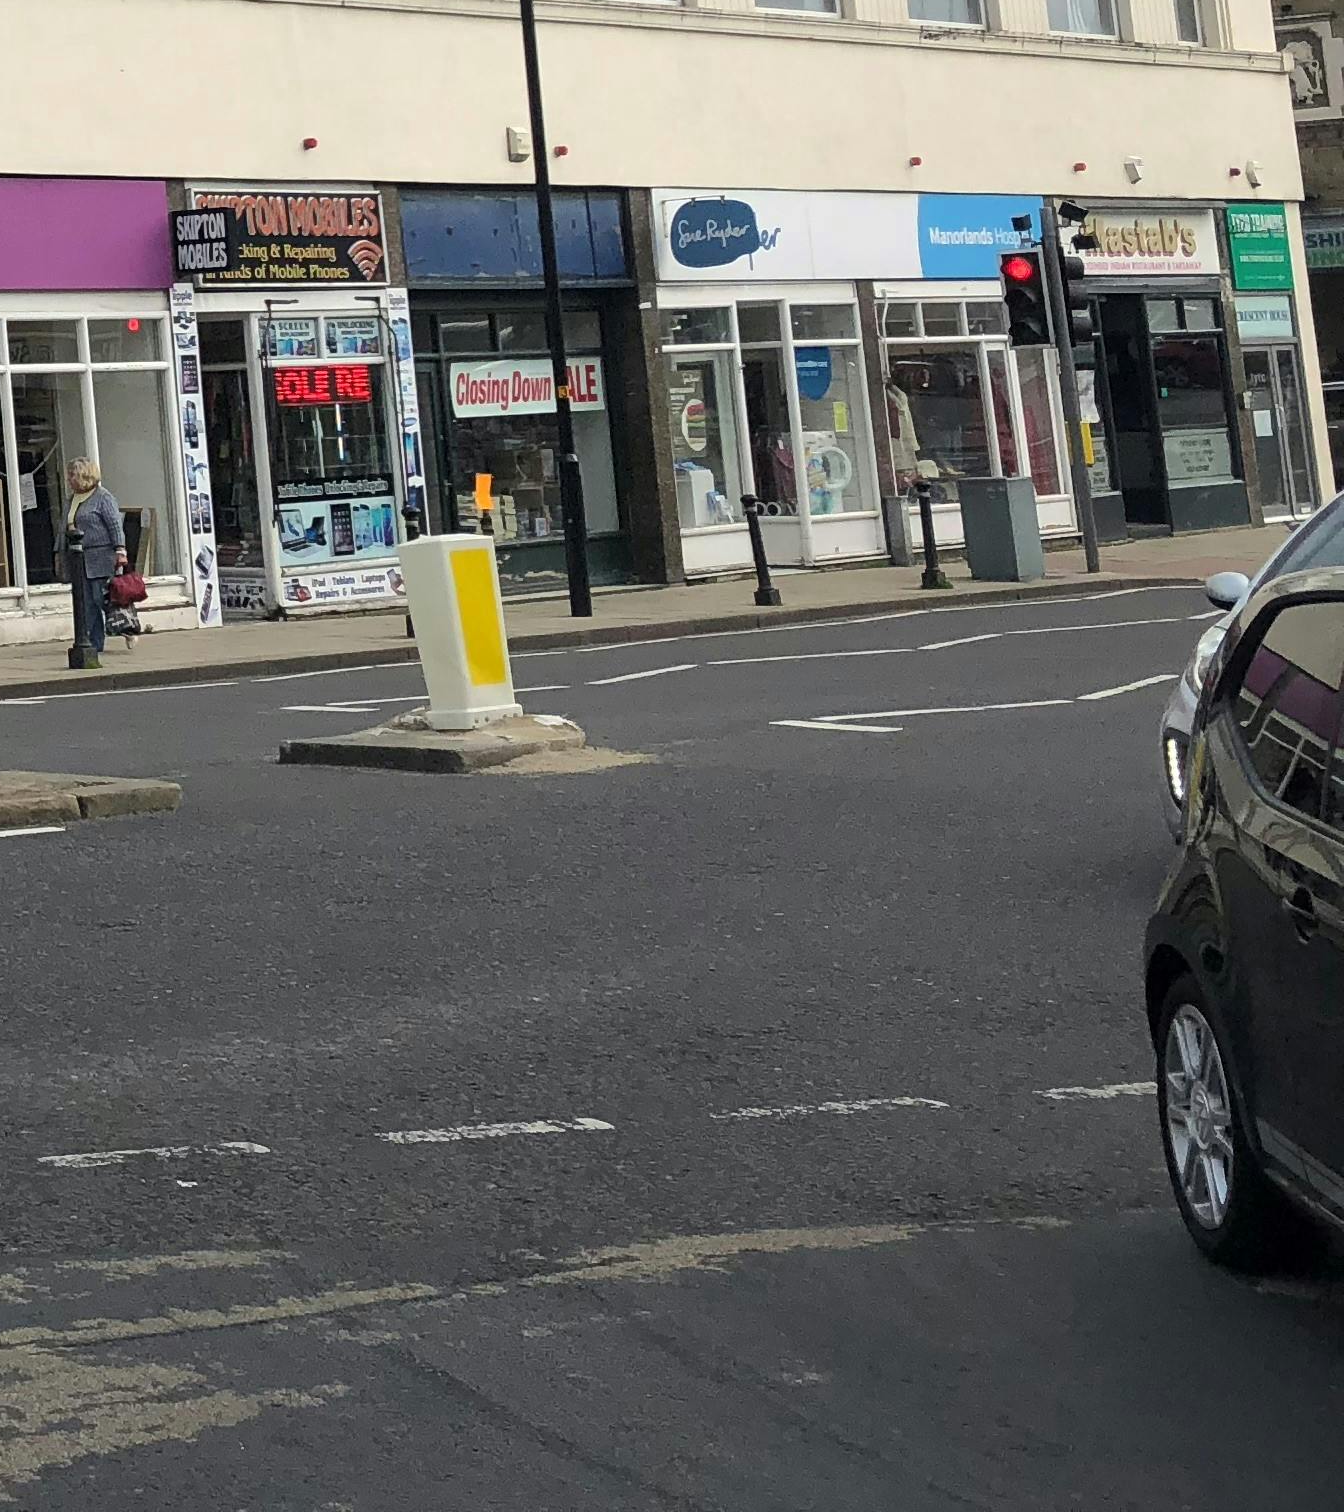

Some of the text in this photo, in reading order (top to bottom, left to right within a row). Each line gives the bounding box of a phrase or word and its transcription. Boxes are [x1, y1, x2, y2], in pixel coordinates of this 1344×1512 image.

[176, 212, 226, 241] SKIPTON
[195, 194, 378, 237] PTON MOBILES
[678, 219, 706, 248] Sue
[706, 219, 750, 248] Ryder
[929, 227, 994, 245] Manorlands
[1305, 233, 1343, 248] SHI
[177, 241, 228, 271] MOBILES
[239, 243, 337, 262] cking & Repairing
[255, 264, 267, 279] of
[269, 264, 308, 279] Mobile
[309, 264, 350, 279] Phones
[456, 364, 599, 411] Closing Down ALE
